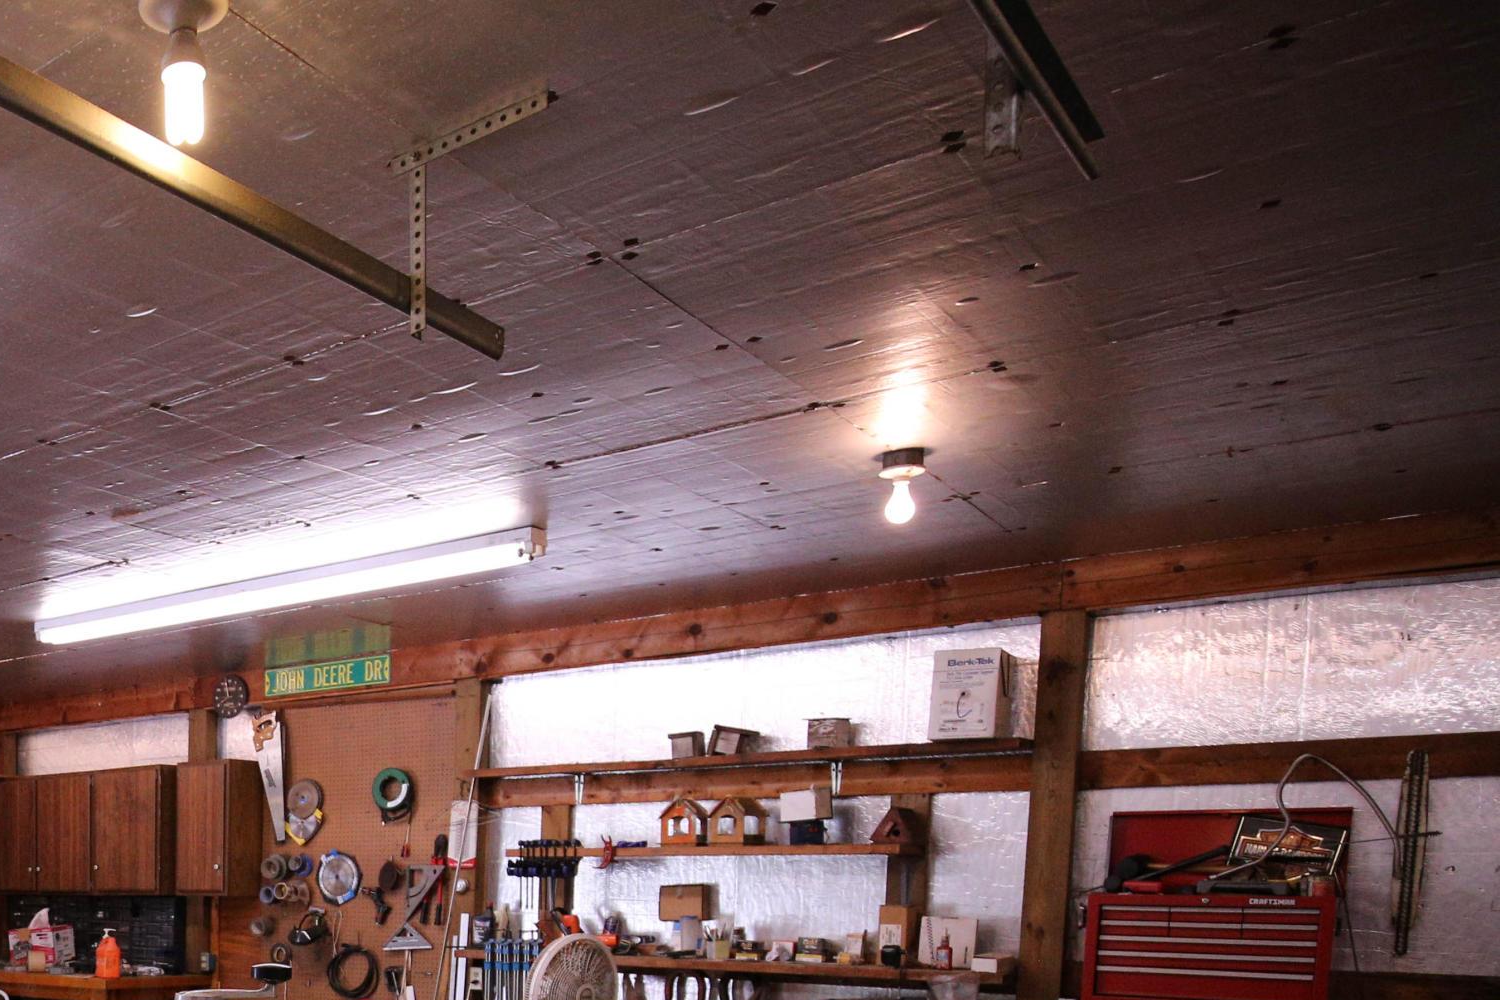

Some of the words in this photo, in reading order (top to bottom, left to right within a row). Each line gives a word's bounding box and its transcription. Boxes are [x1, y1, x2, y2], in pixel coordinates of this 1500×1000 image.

[273, 669, 305, 692] JOHN
[313, 663, 355, 687] DEERE
[364, 660, 382, 681] DR
[1248, 898, 1296, 906] CRAFTSMAN
